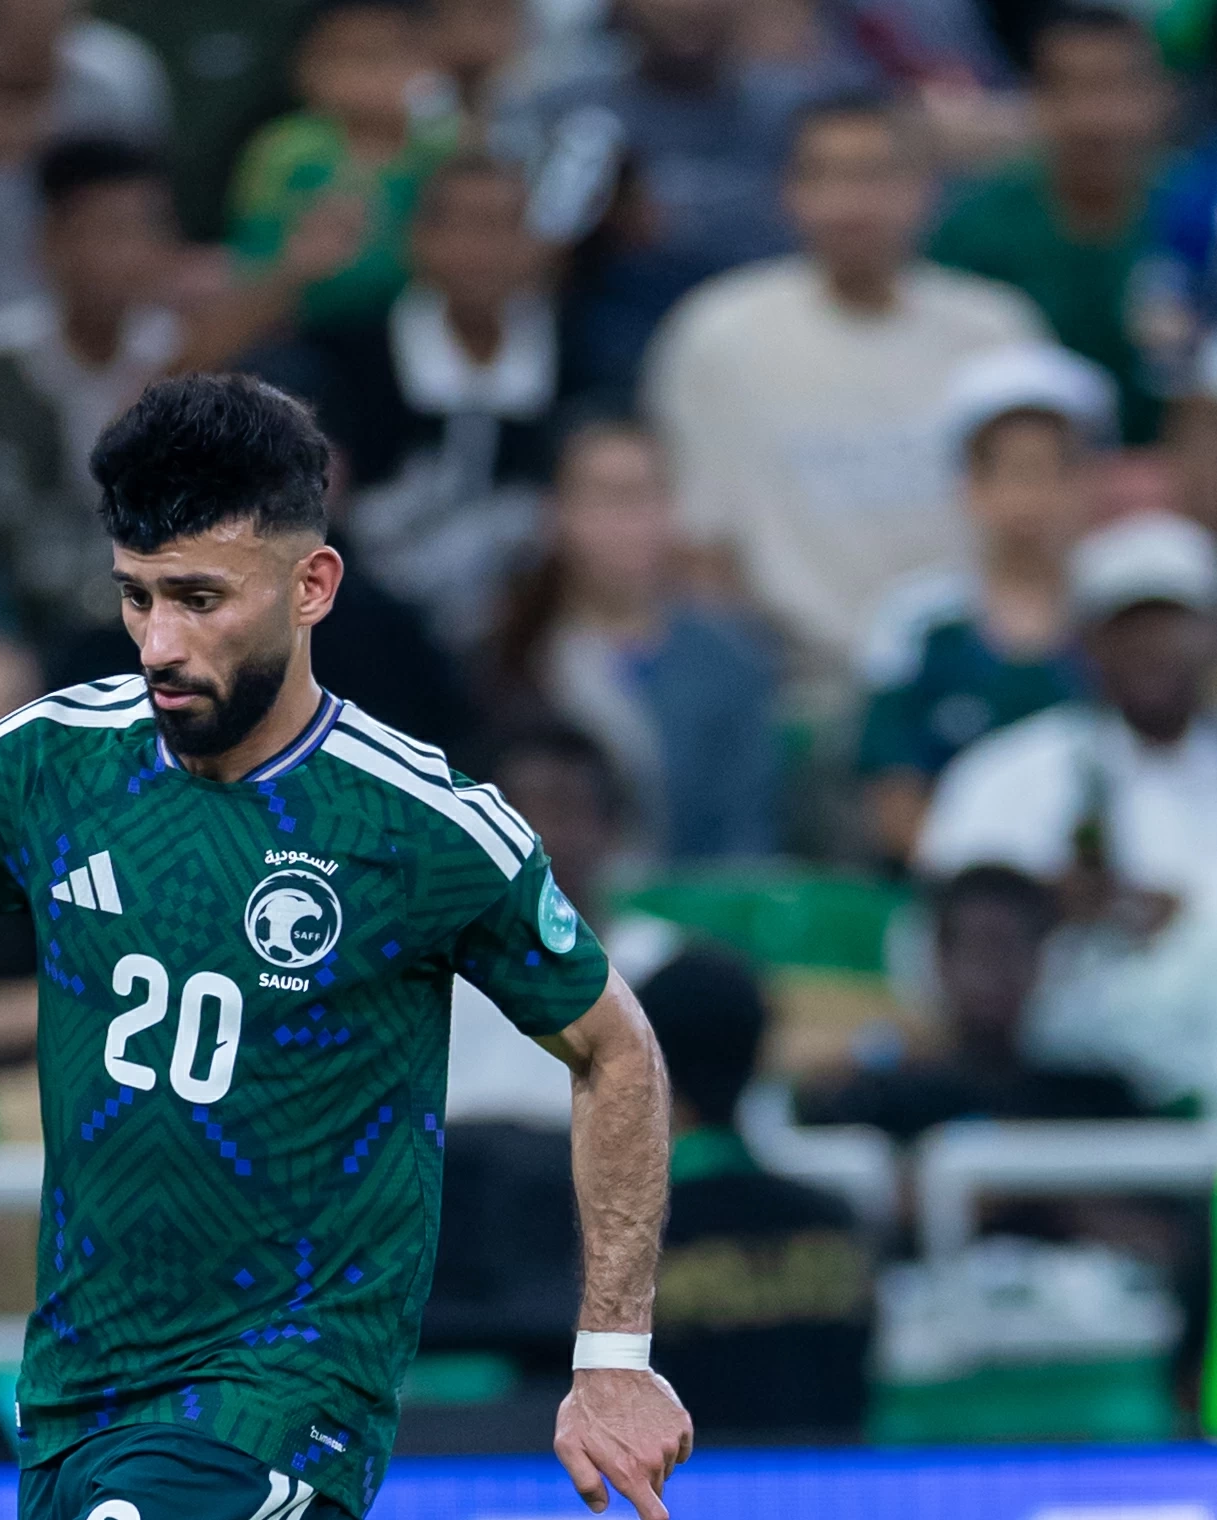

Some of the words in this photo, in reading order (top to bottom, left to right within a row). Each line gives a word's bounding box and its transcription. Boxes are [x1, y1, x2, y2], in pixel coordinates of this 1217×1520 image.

[264, 849, 339, 876] السعودية
[293, 930, 321, 941] SAFF
[259, 973, 309, 992] SAUDI
[104, 953, 243, 1104] 20
